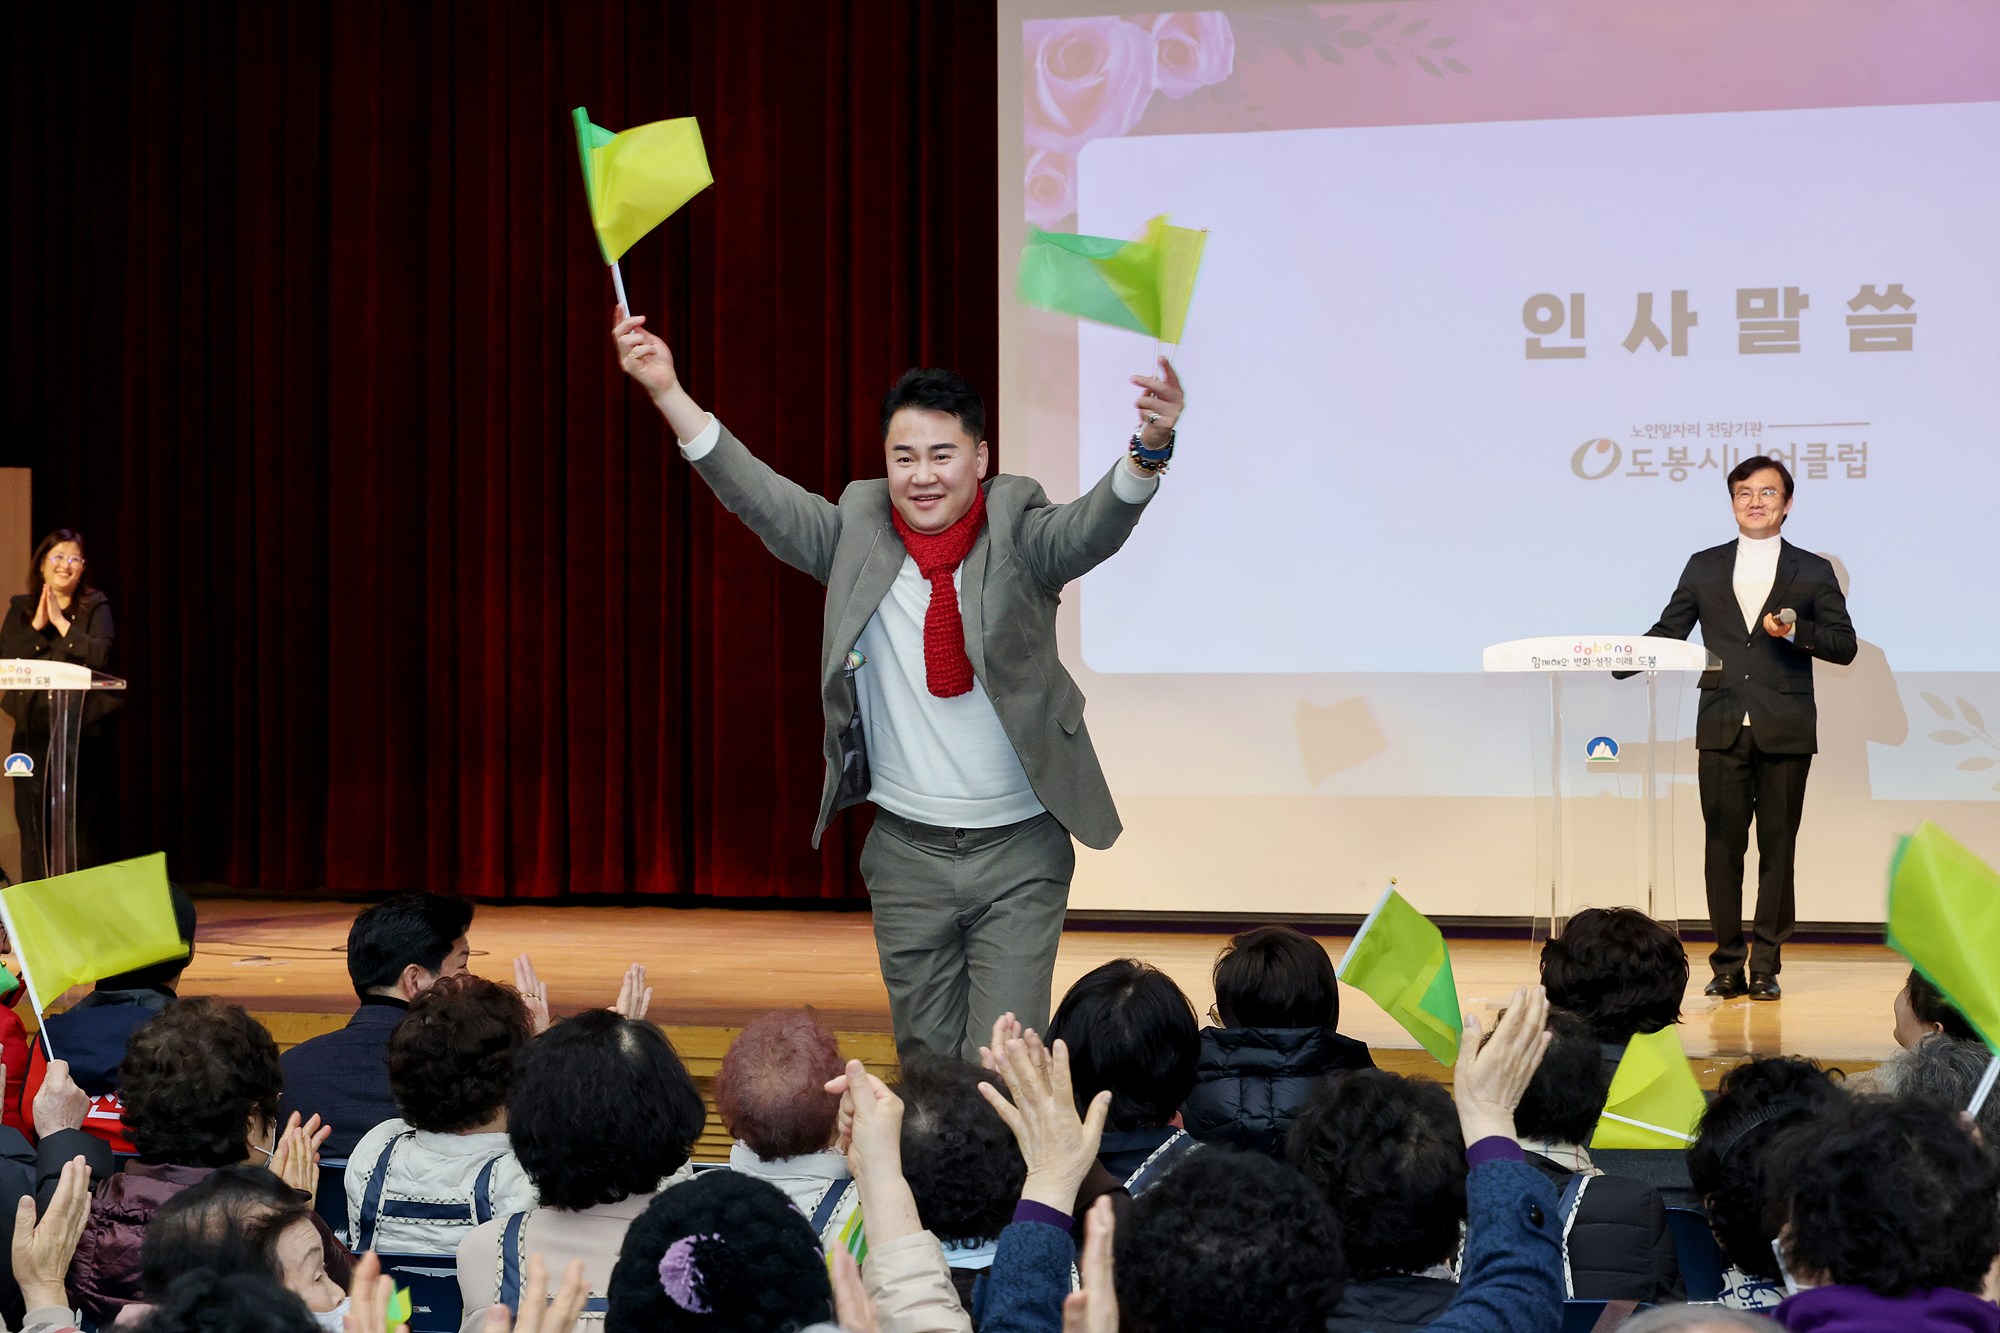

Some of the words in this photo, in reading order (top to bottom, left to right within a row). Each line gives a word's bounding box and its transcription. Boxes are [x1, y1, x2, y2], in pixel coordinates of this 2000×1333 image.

[1630, 422, 1700, 439] 노인일자리
[1706, 422, 1763, 438] 전담기관
[1574, 642, 1633, 656] dobong
[1639, 656, 1657, 669] 도봉
[35, 676, 51, 687] 도봉
